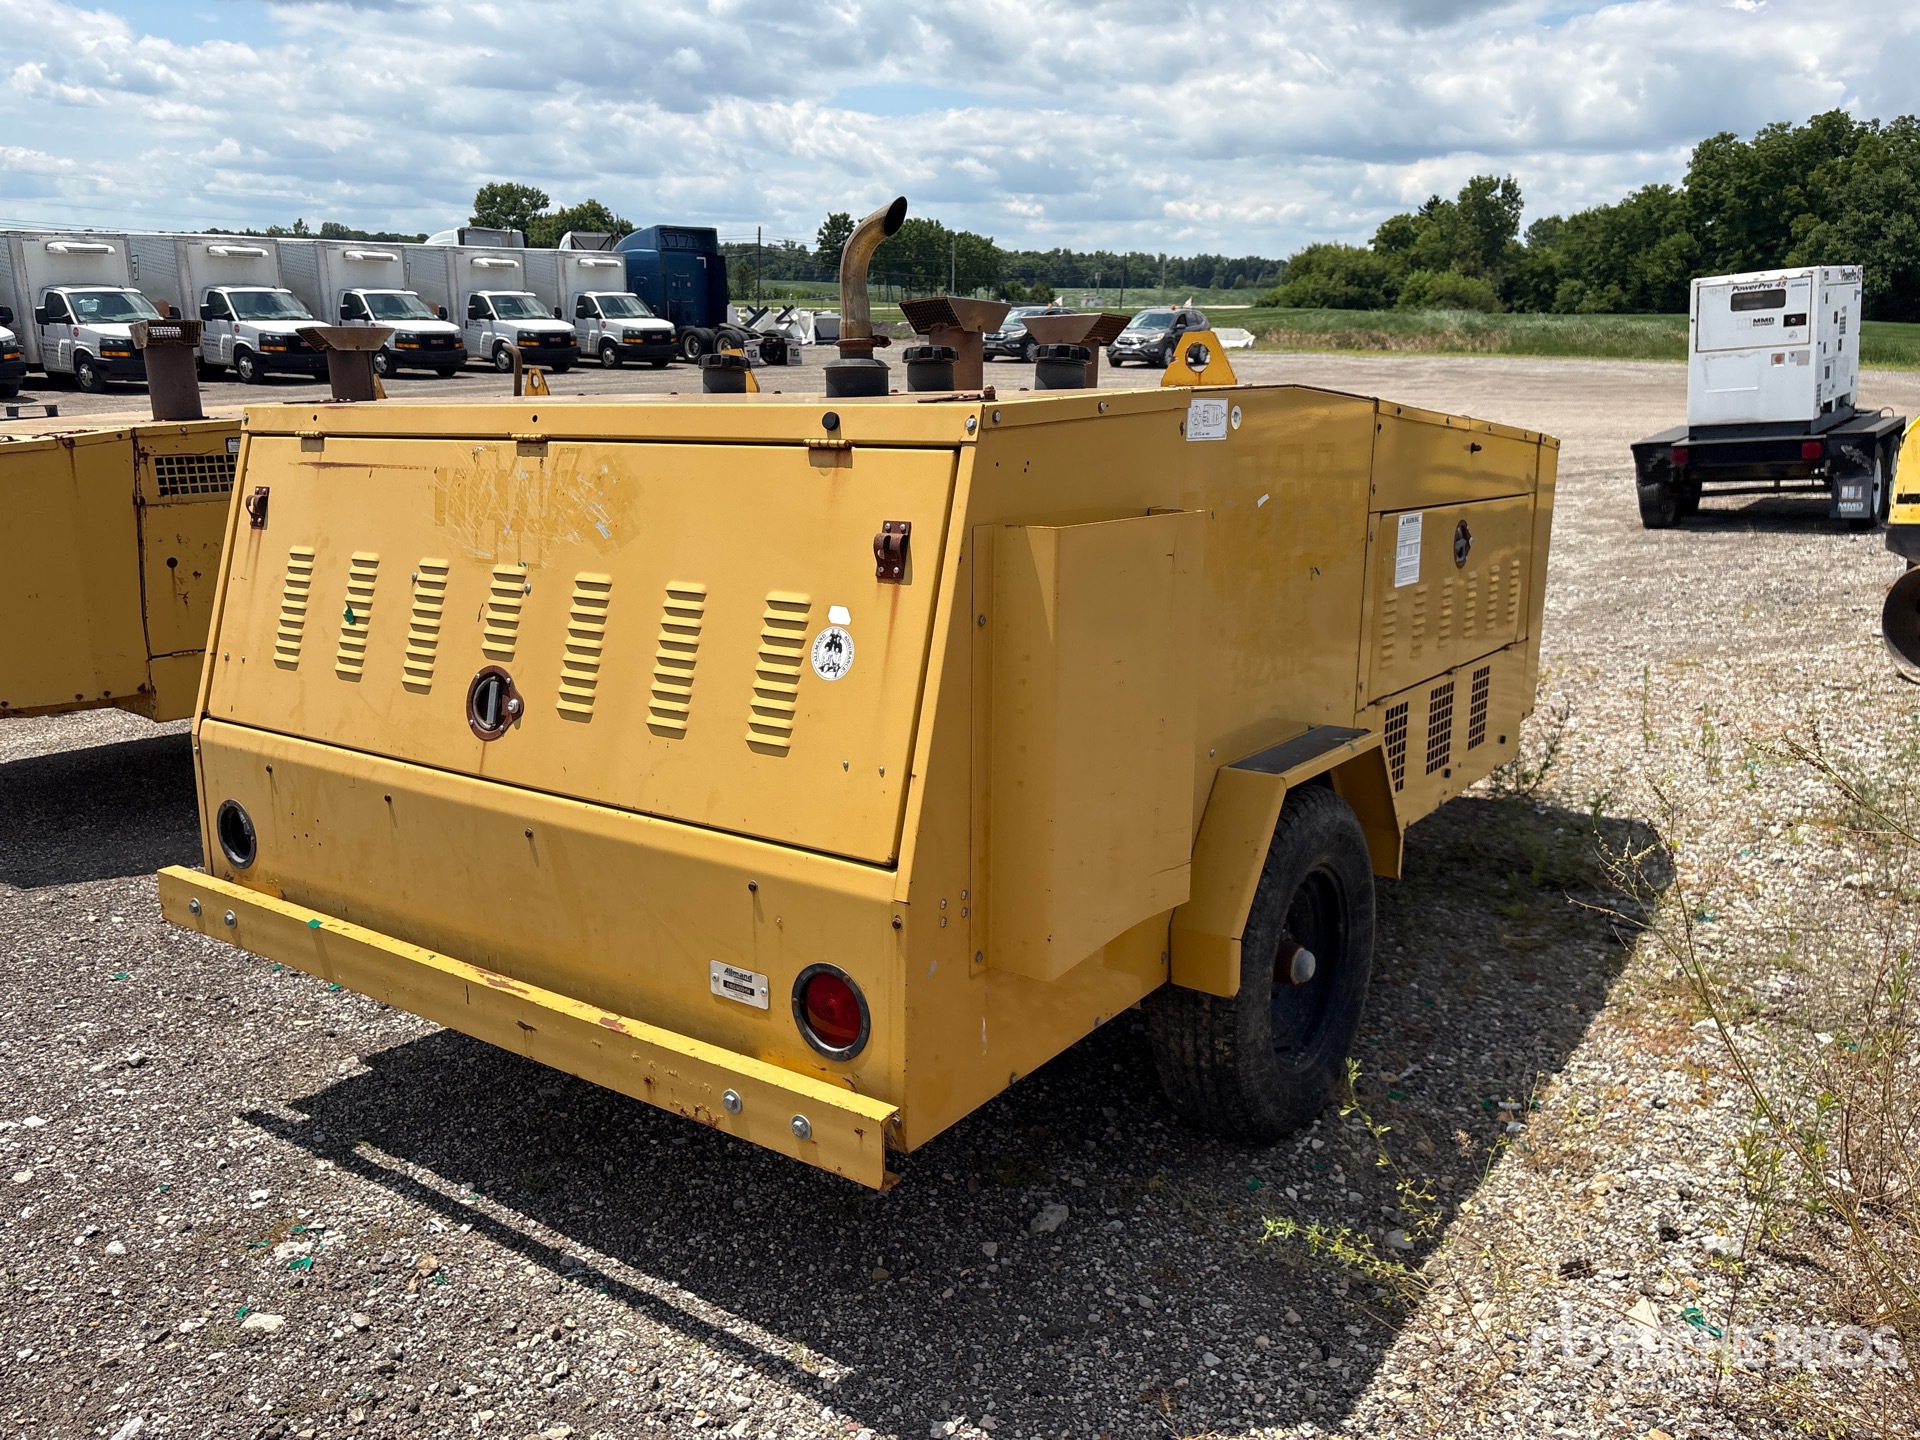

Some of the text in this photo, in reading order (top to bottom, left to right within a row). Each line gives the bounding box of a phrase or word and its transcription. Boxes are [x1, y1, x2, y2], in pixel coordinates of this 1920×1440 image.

[1732, 280, 1787, 292] PowerPro 45
[724, 967, 753, 981] Allmand
